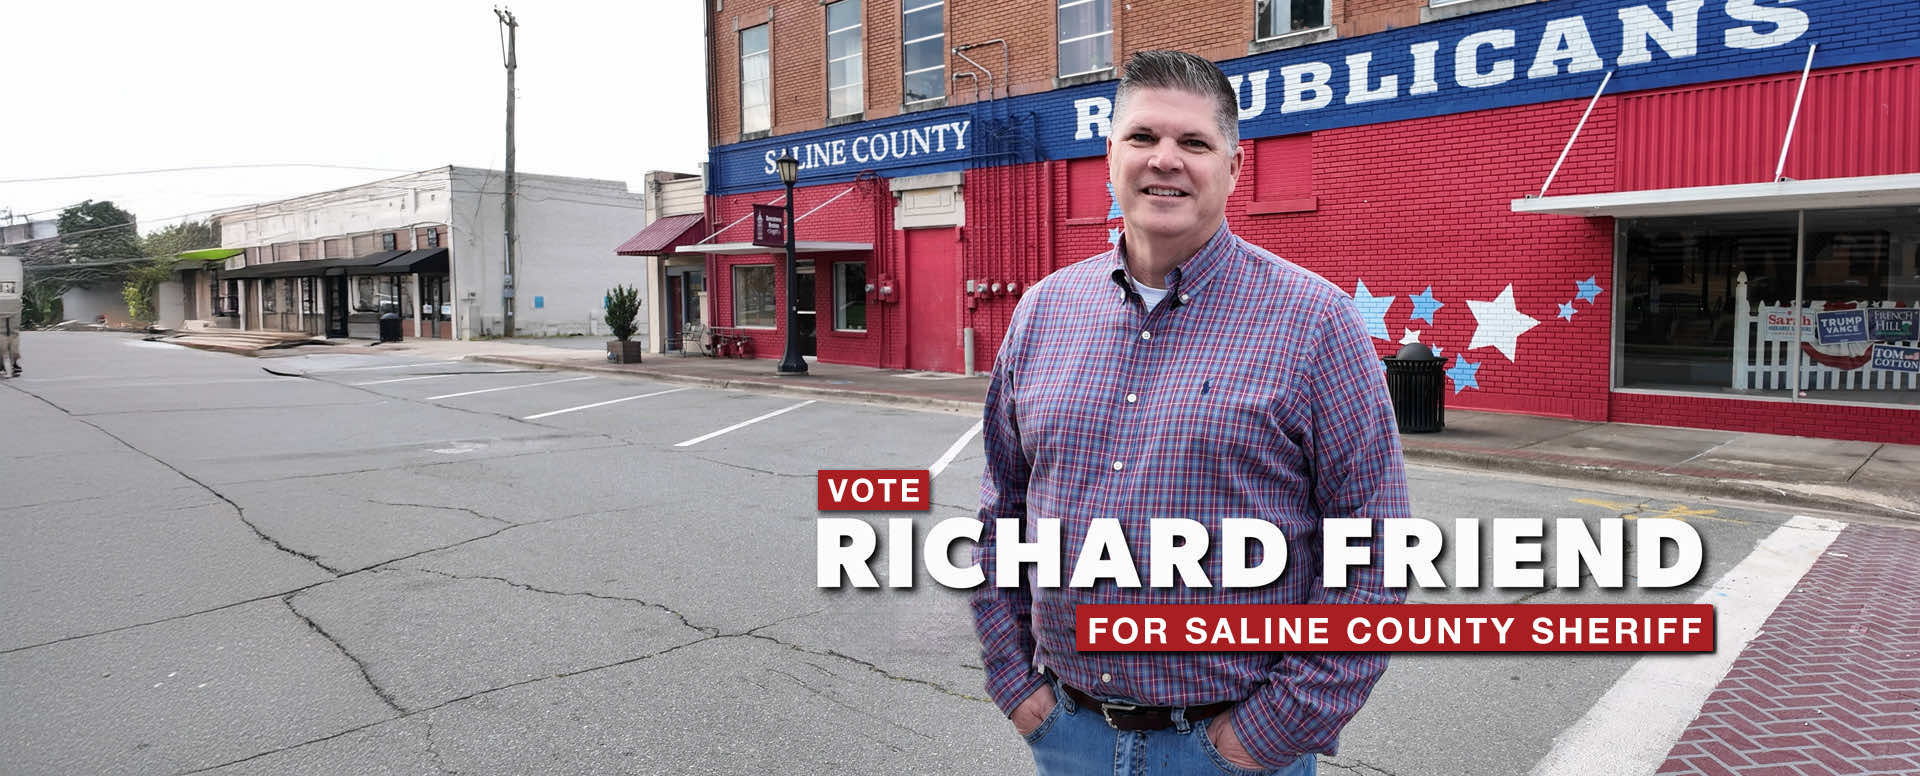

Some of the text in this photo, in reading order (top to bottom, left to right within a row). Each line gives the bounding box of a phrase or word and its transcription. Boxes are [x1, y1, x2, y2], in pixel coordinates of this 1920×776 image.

[852, 121, 970, 163] COUNTY
[1074, 0, 1810, 141] RUBLICANS
[1768, 314, 1811, 325] Sarh
[1874, 311, 1913, 320] FRENCH
[1821, 316, 1862, 327] TRUMP
[1876, 321, 1901, 331] HILL
[1826, 325, 1859, 334] VANCE
[1875, 348, 1904, 359] TOM
[1874, 358, 1919, 369] COTTON
